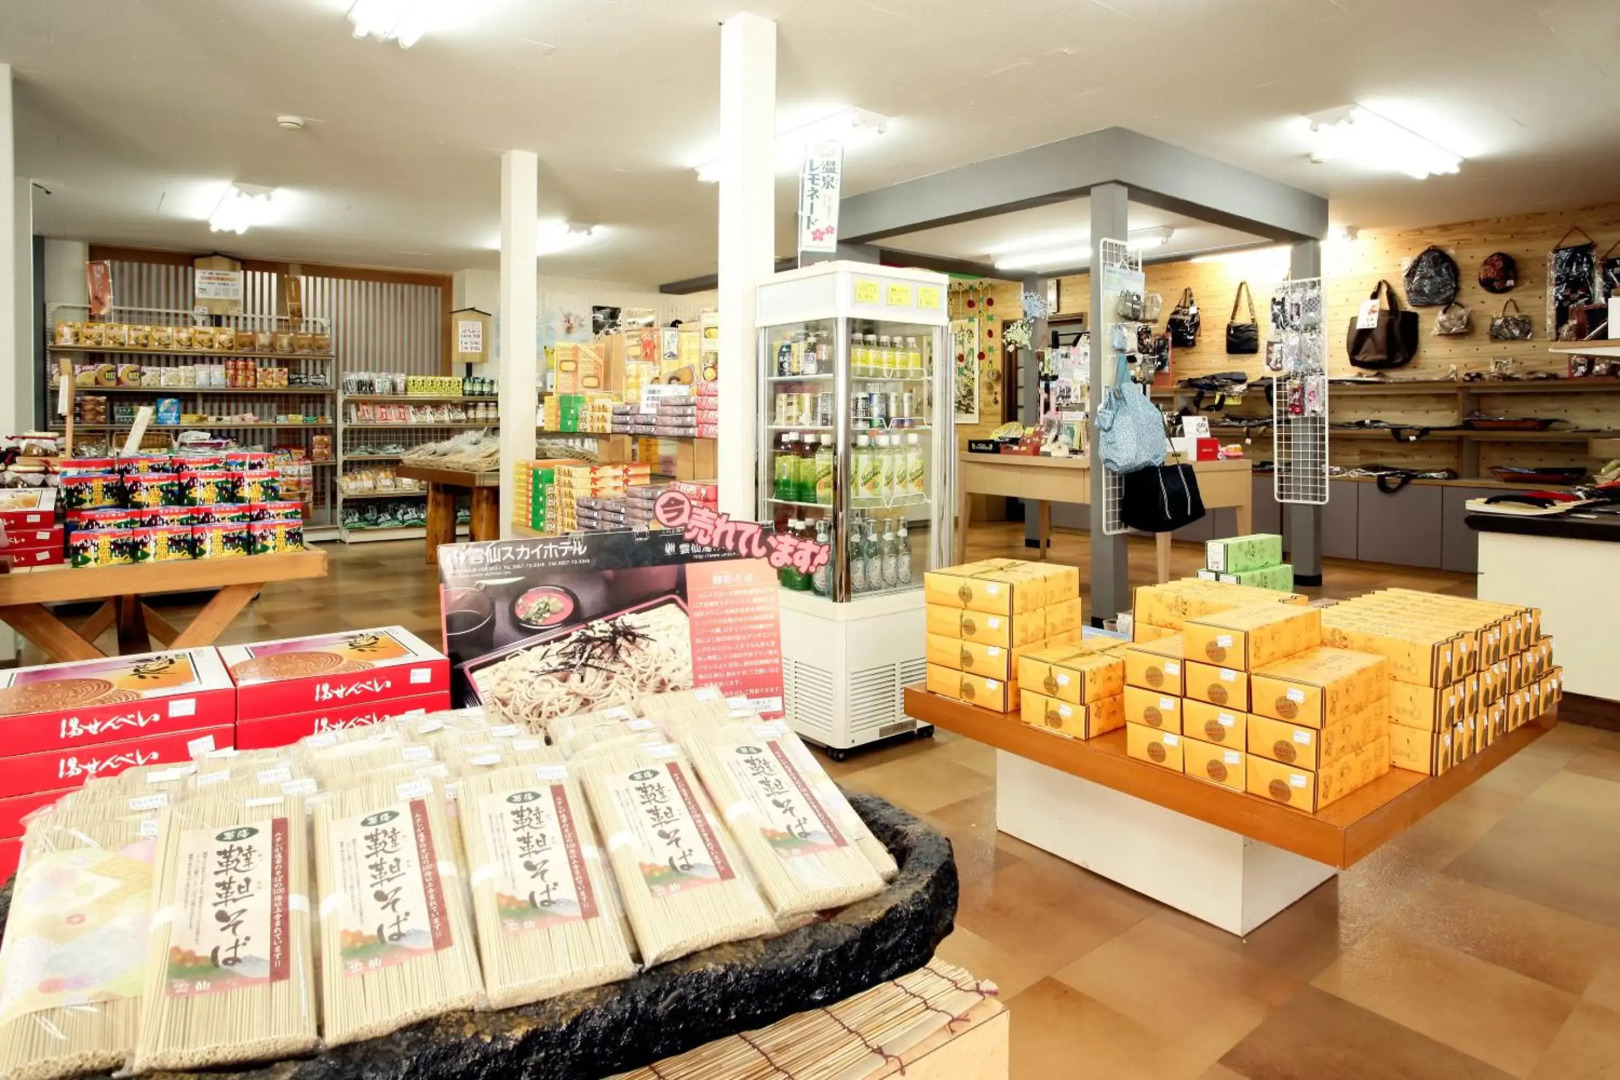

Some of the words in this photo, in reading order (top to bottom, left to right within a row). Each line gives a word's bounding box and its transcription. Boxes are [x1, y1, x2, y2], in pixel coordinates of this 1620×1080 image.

[806, 159, 820, 231] レモネード
[821, 160, 839, 190] 温泉
[467, 541, 588, 565] 雲仙スカイホテル
[315, 678, 392, 702] 湯せんべい
[60, 710, 161, 738] 湯せんべい
[58, 748, 160, 778] 湯せんべい
[634, 782, 694, 874] 韃靼そば
[509, 805, 560, 909] 韃靼そば
[210, 844, 258, 969] 韃靼そば
[363, 826, 411, 945] 韃靼そば
